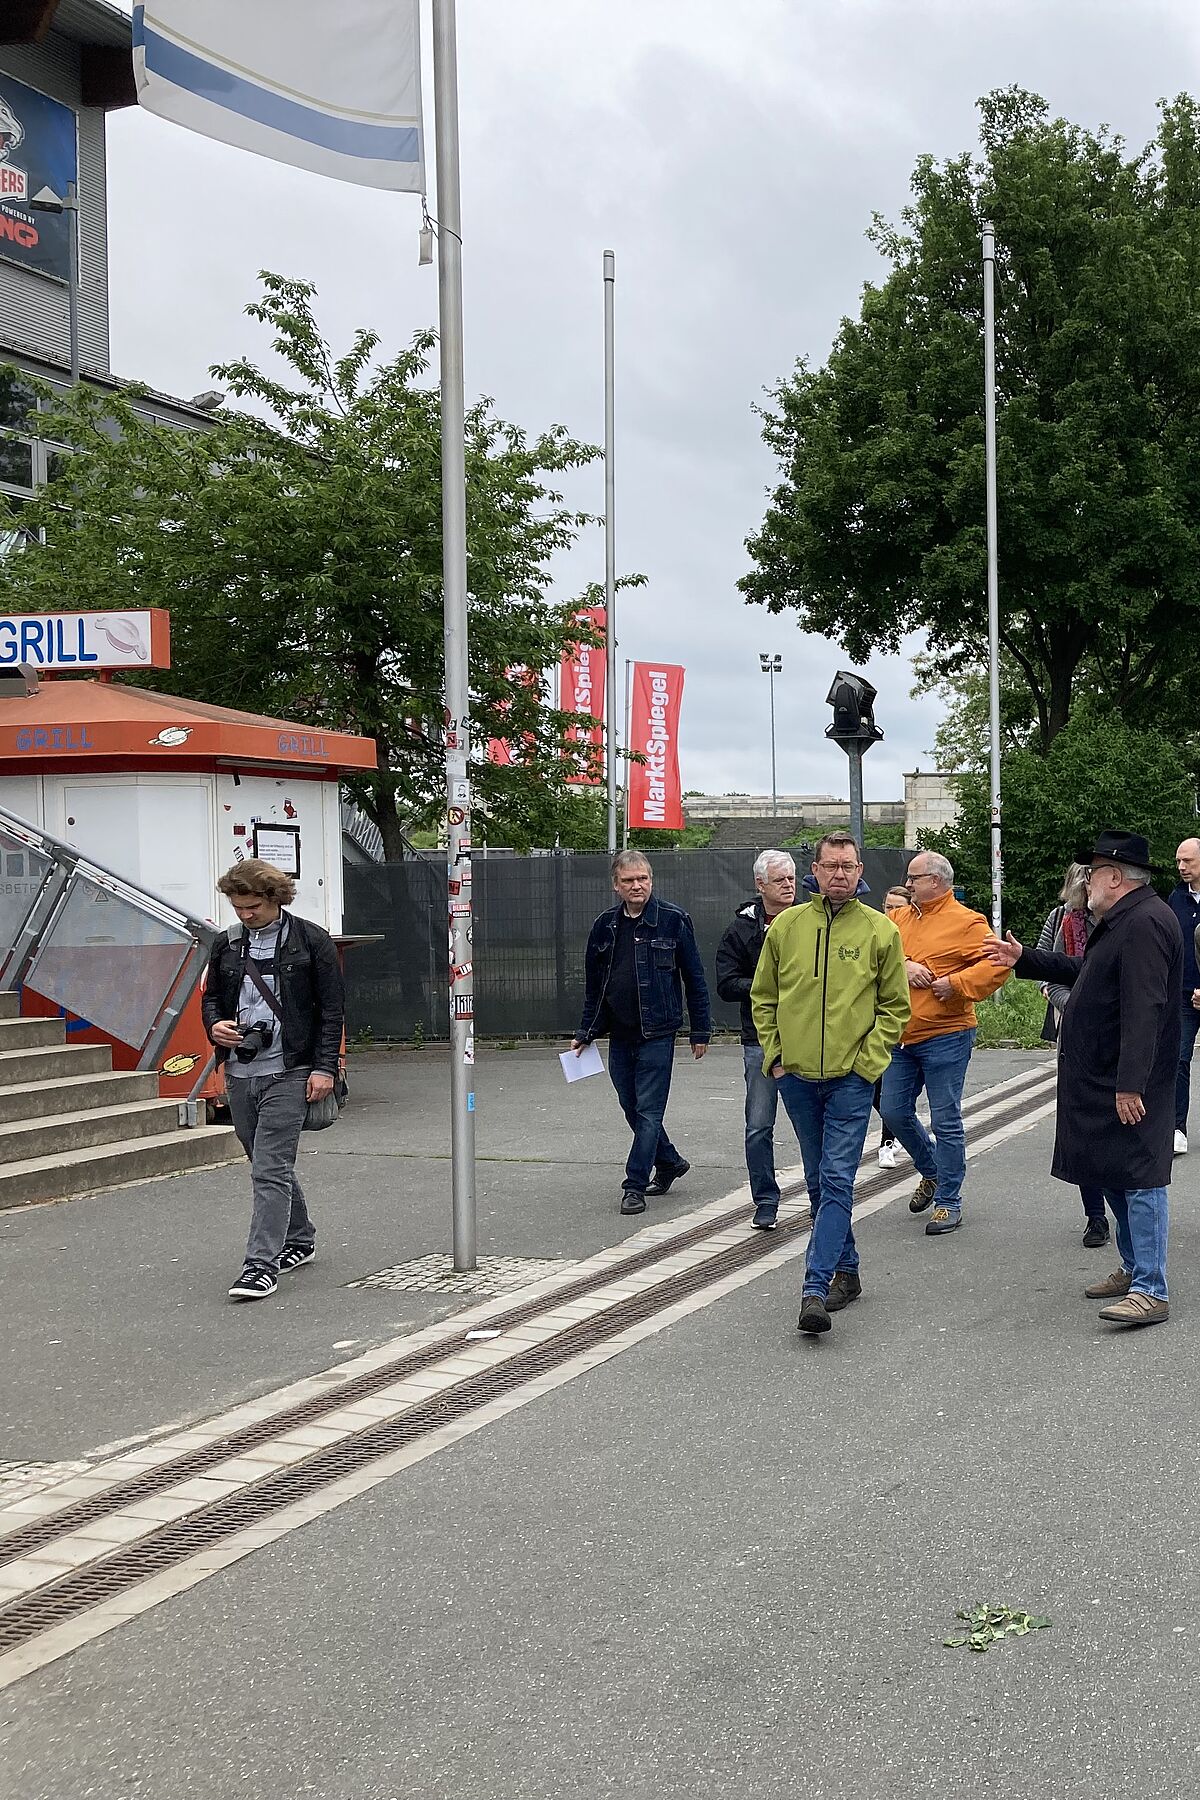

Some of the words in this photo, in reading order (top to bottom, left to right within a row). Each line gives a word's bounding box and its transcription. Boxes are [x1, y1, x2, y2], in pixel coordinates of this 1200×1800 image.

[2, 204, 27, 221] POWERED
[0, 618, 98, 663] GRILL
[16, 726, 95, 751] GRILL
[277, 734, 330, 757] GRILL
[643, 671, 669, 822] MarktSpiegel
